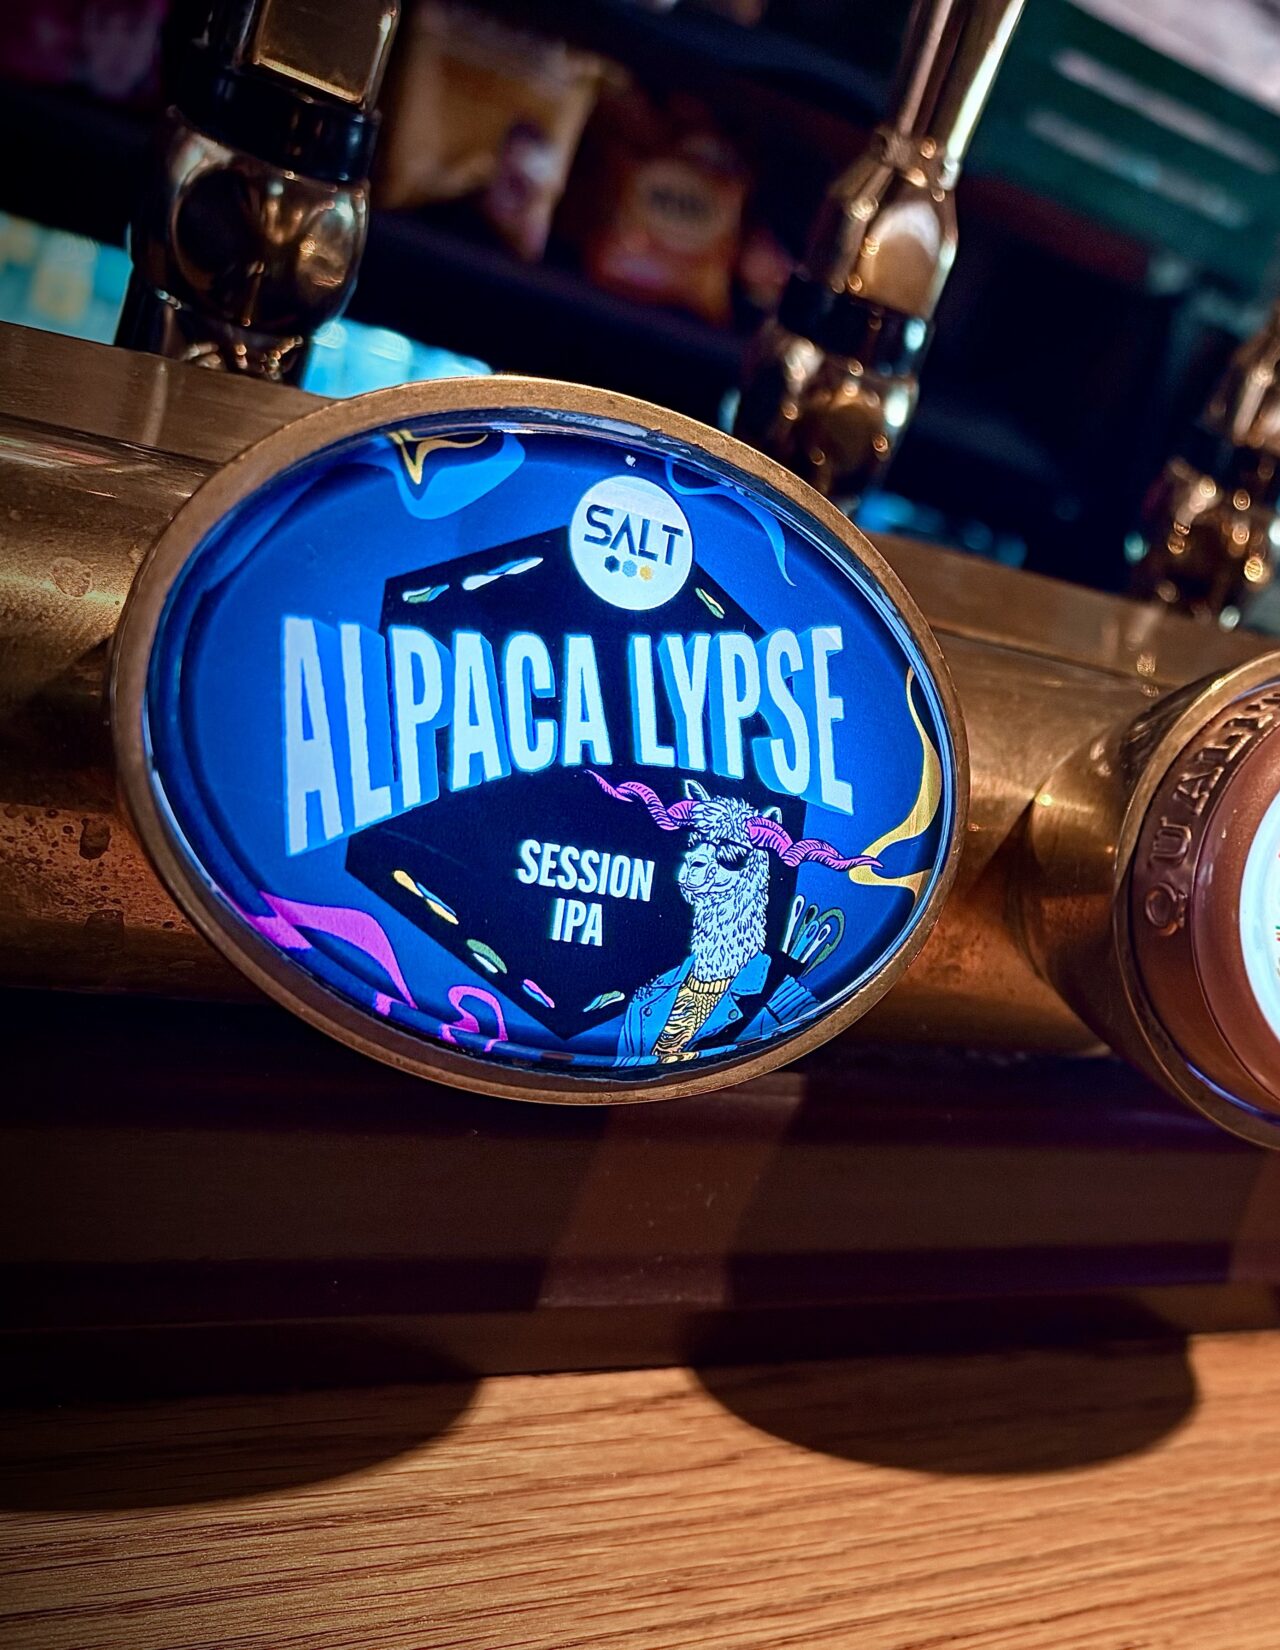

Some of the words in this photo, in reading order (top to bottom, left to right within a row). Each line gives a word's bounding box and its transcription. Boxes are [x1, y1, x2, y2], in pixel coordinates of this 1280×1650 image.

[583, 503, 685, 567] SALT
[283, 615, 613, 857] ALPACA
[629, 625, 855, 816] LYPSE
[515, 838, 656, 902] SESSION
[550, 897, 603, 947] IPA
